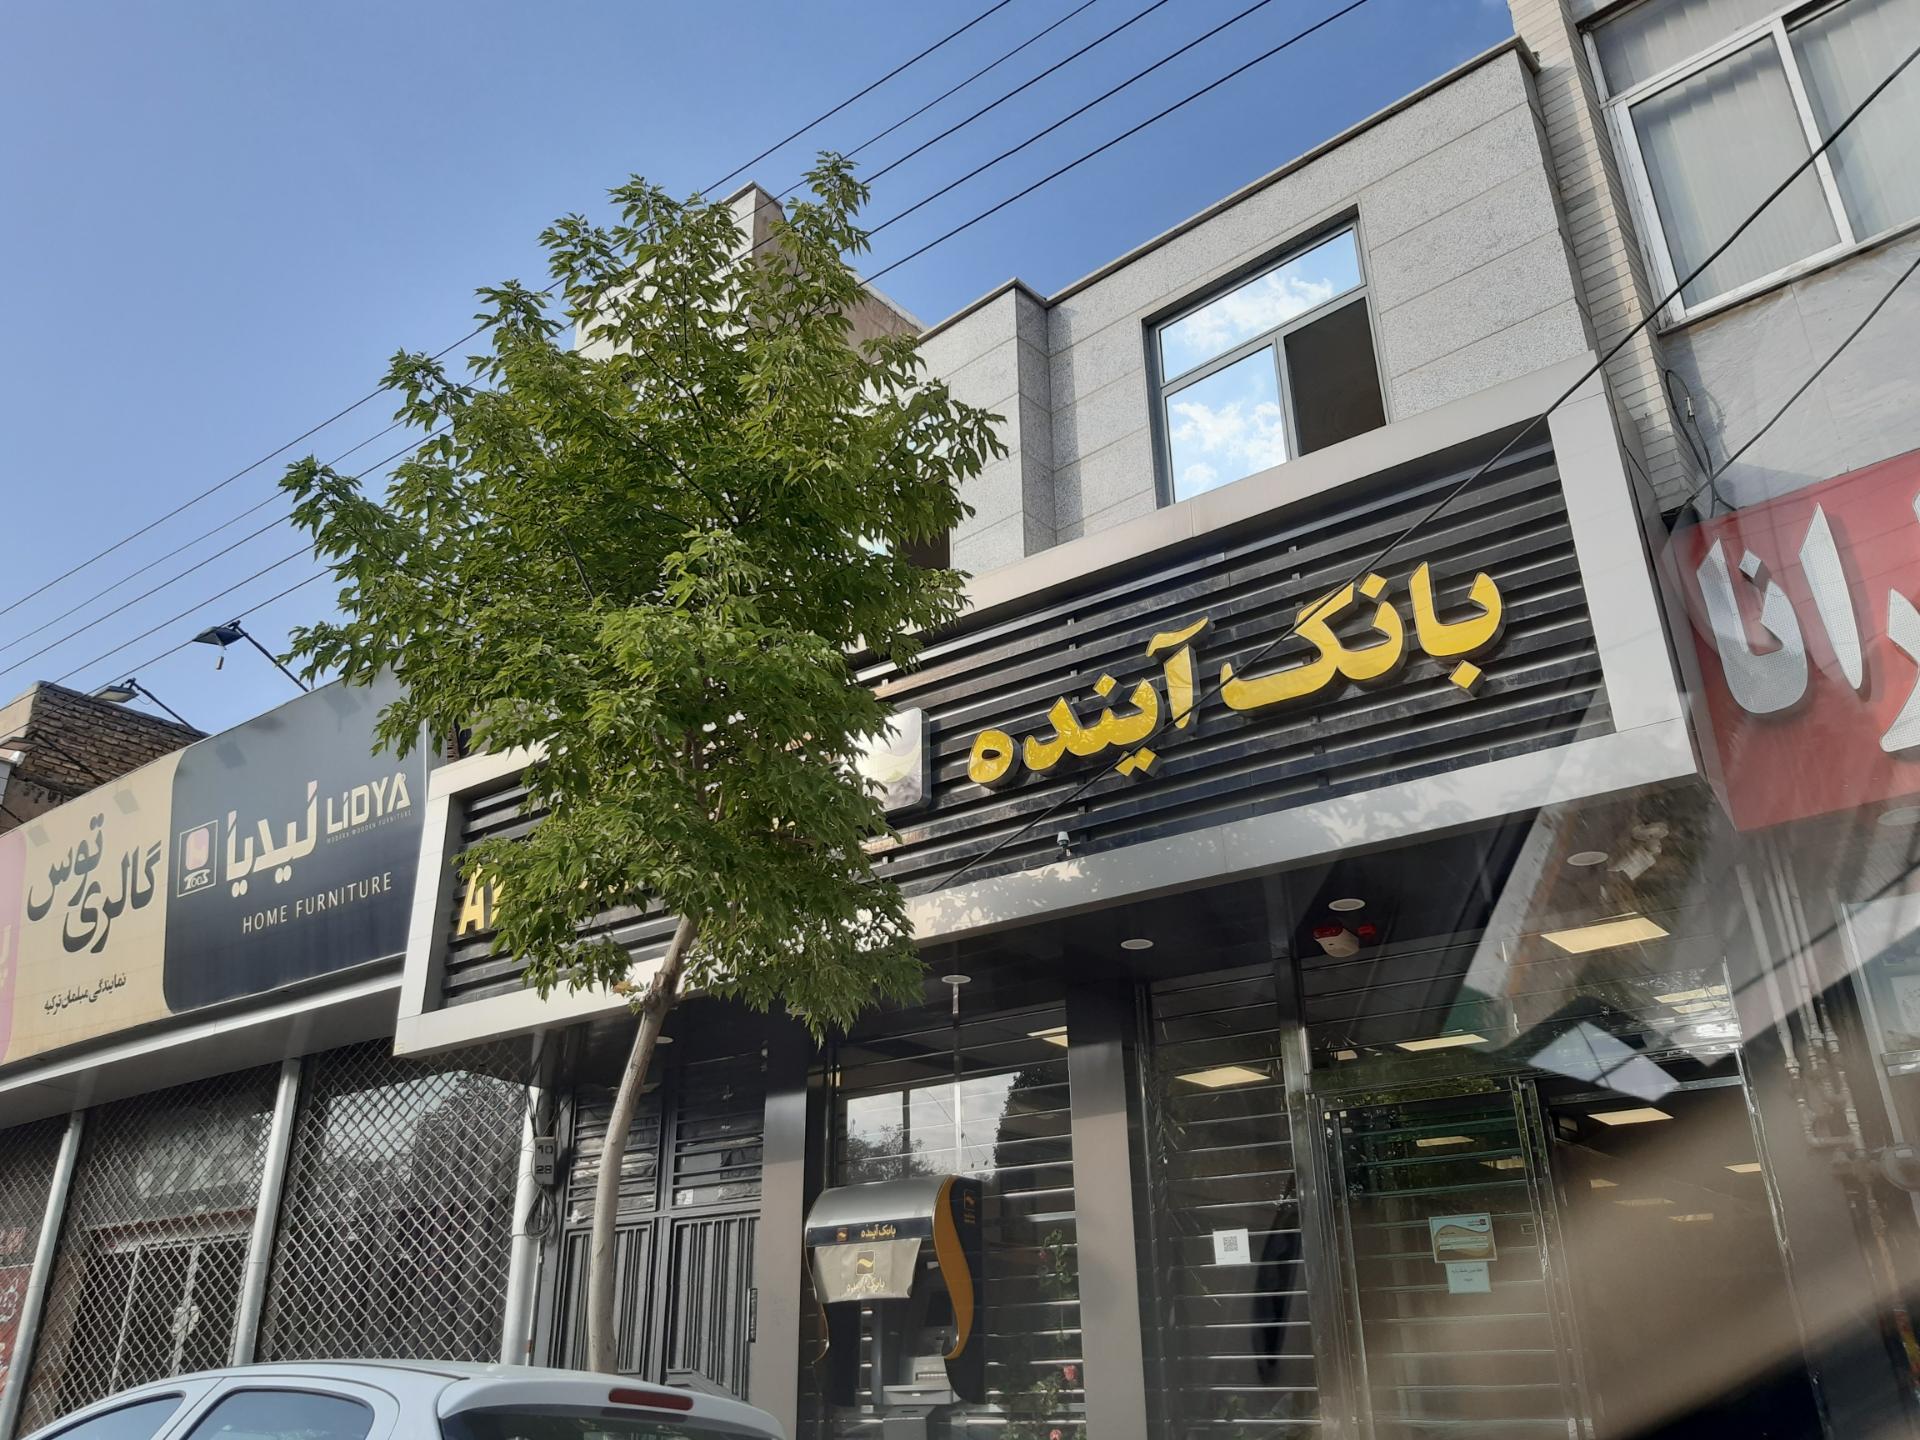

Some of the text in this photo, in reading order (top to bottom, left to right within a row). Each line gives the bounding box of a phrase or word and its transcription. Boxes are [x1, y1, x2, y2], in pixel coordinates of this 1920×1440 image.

[966, 561, 1503, 784] بانک آینده
[27, 813, 105, 921] توس
[226, 779, 318, 898] لیدیا
[62, 840, 161, 953] گالری
[243, 872, 392, 934] HOME FURNITURE
